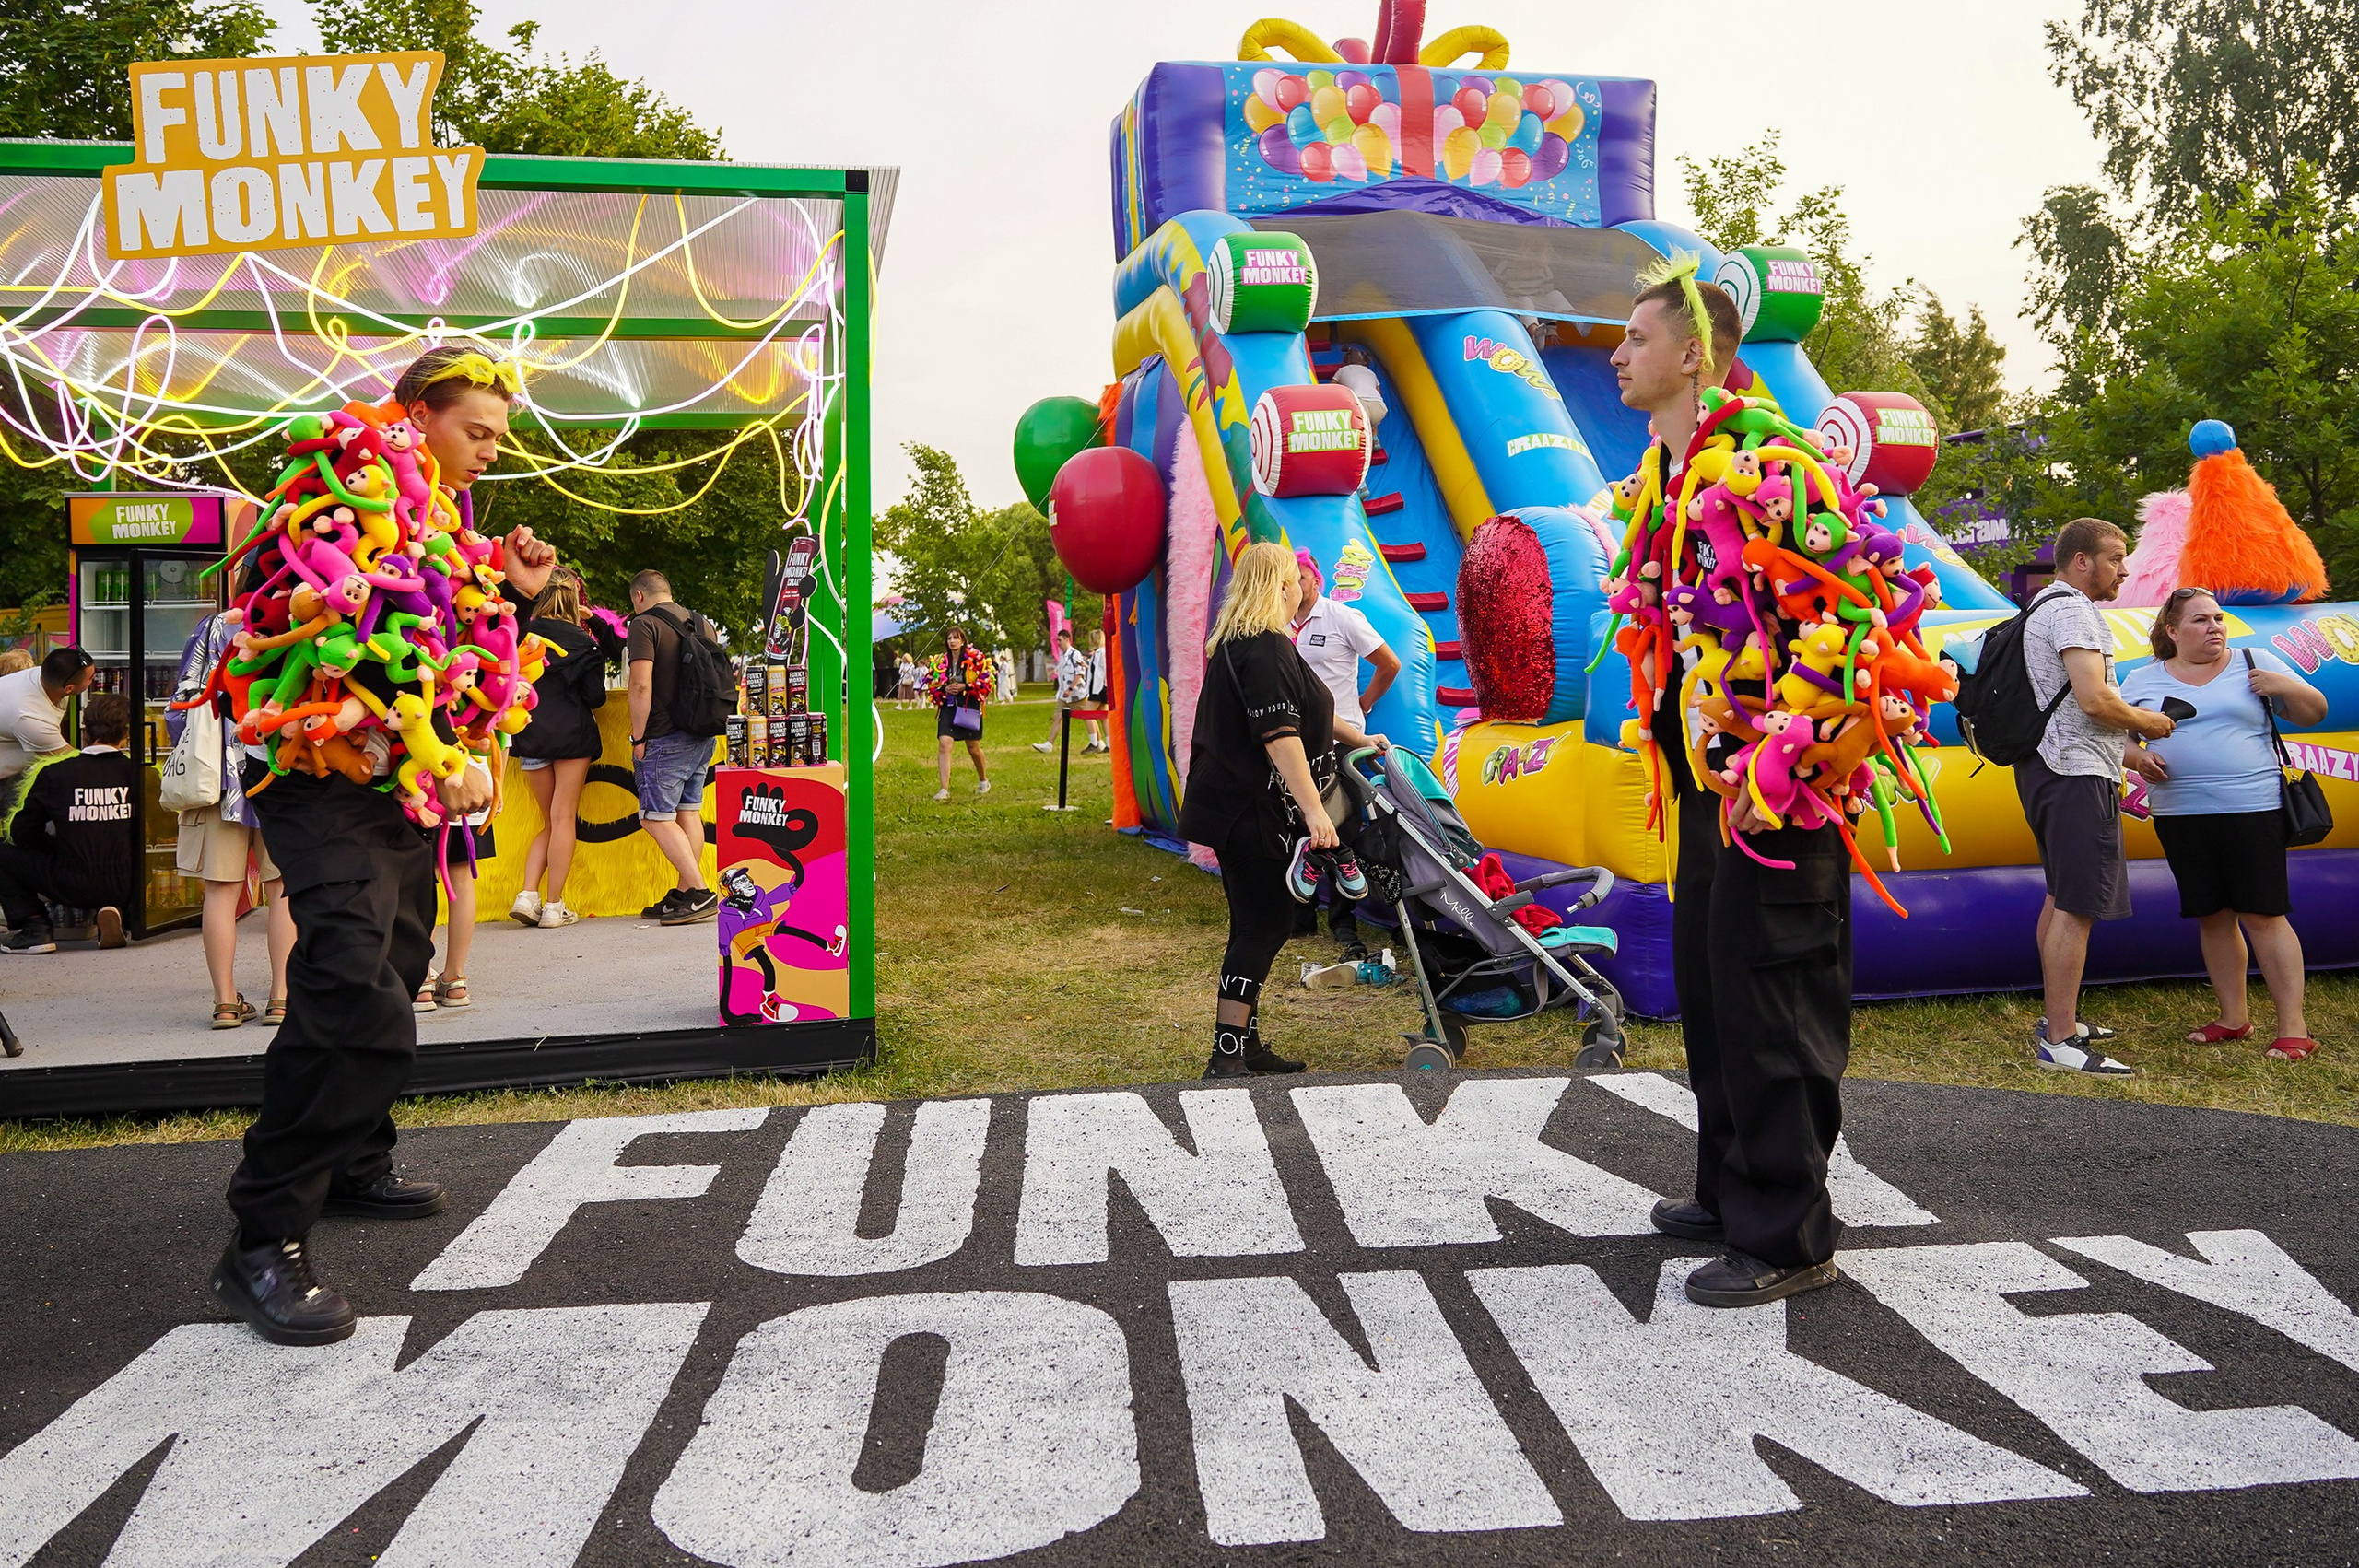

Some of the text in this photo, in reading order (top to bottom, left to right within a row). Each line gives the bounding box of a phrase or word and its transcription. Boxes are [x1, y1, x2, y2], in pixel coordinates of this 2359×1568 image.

[139, 61, 435, 164] FUNKY
[116, 153, 472, 251] MONKEY
[1246, 251, 1298, 267] FUNKY
[1243, 266, 1306, 284] MONKEY
[1767, 261, 1814, 278] FUNKY
[1767, 275, 1822, 294] MONKEY
[1293, 411, 1351, 432] FUNKY
[1879, 410, 1928, 428] FUNKY
[1290, 429, 1359, 451] MONKEY
[115, 503, 170, 524] FUNKY
[111, 520, 177, 539] MONKEY
[789, 552, 811, 567] FUNKY
[2271, 612, 2359, 675] WO
[1268, 702, 1286, 714] YOUR
[1481, 731, 1572, 786] CRAAZY
[74, 787, 129, 806] FUNKY
[745, 795, 787, 813] FUNKY
[739, 810, 789, 826] MONKEY
